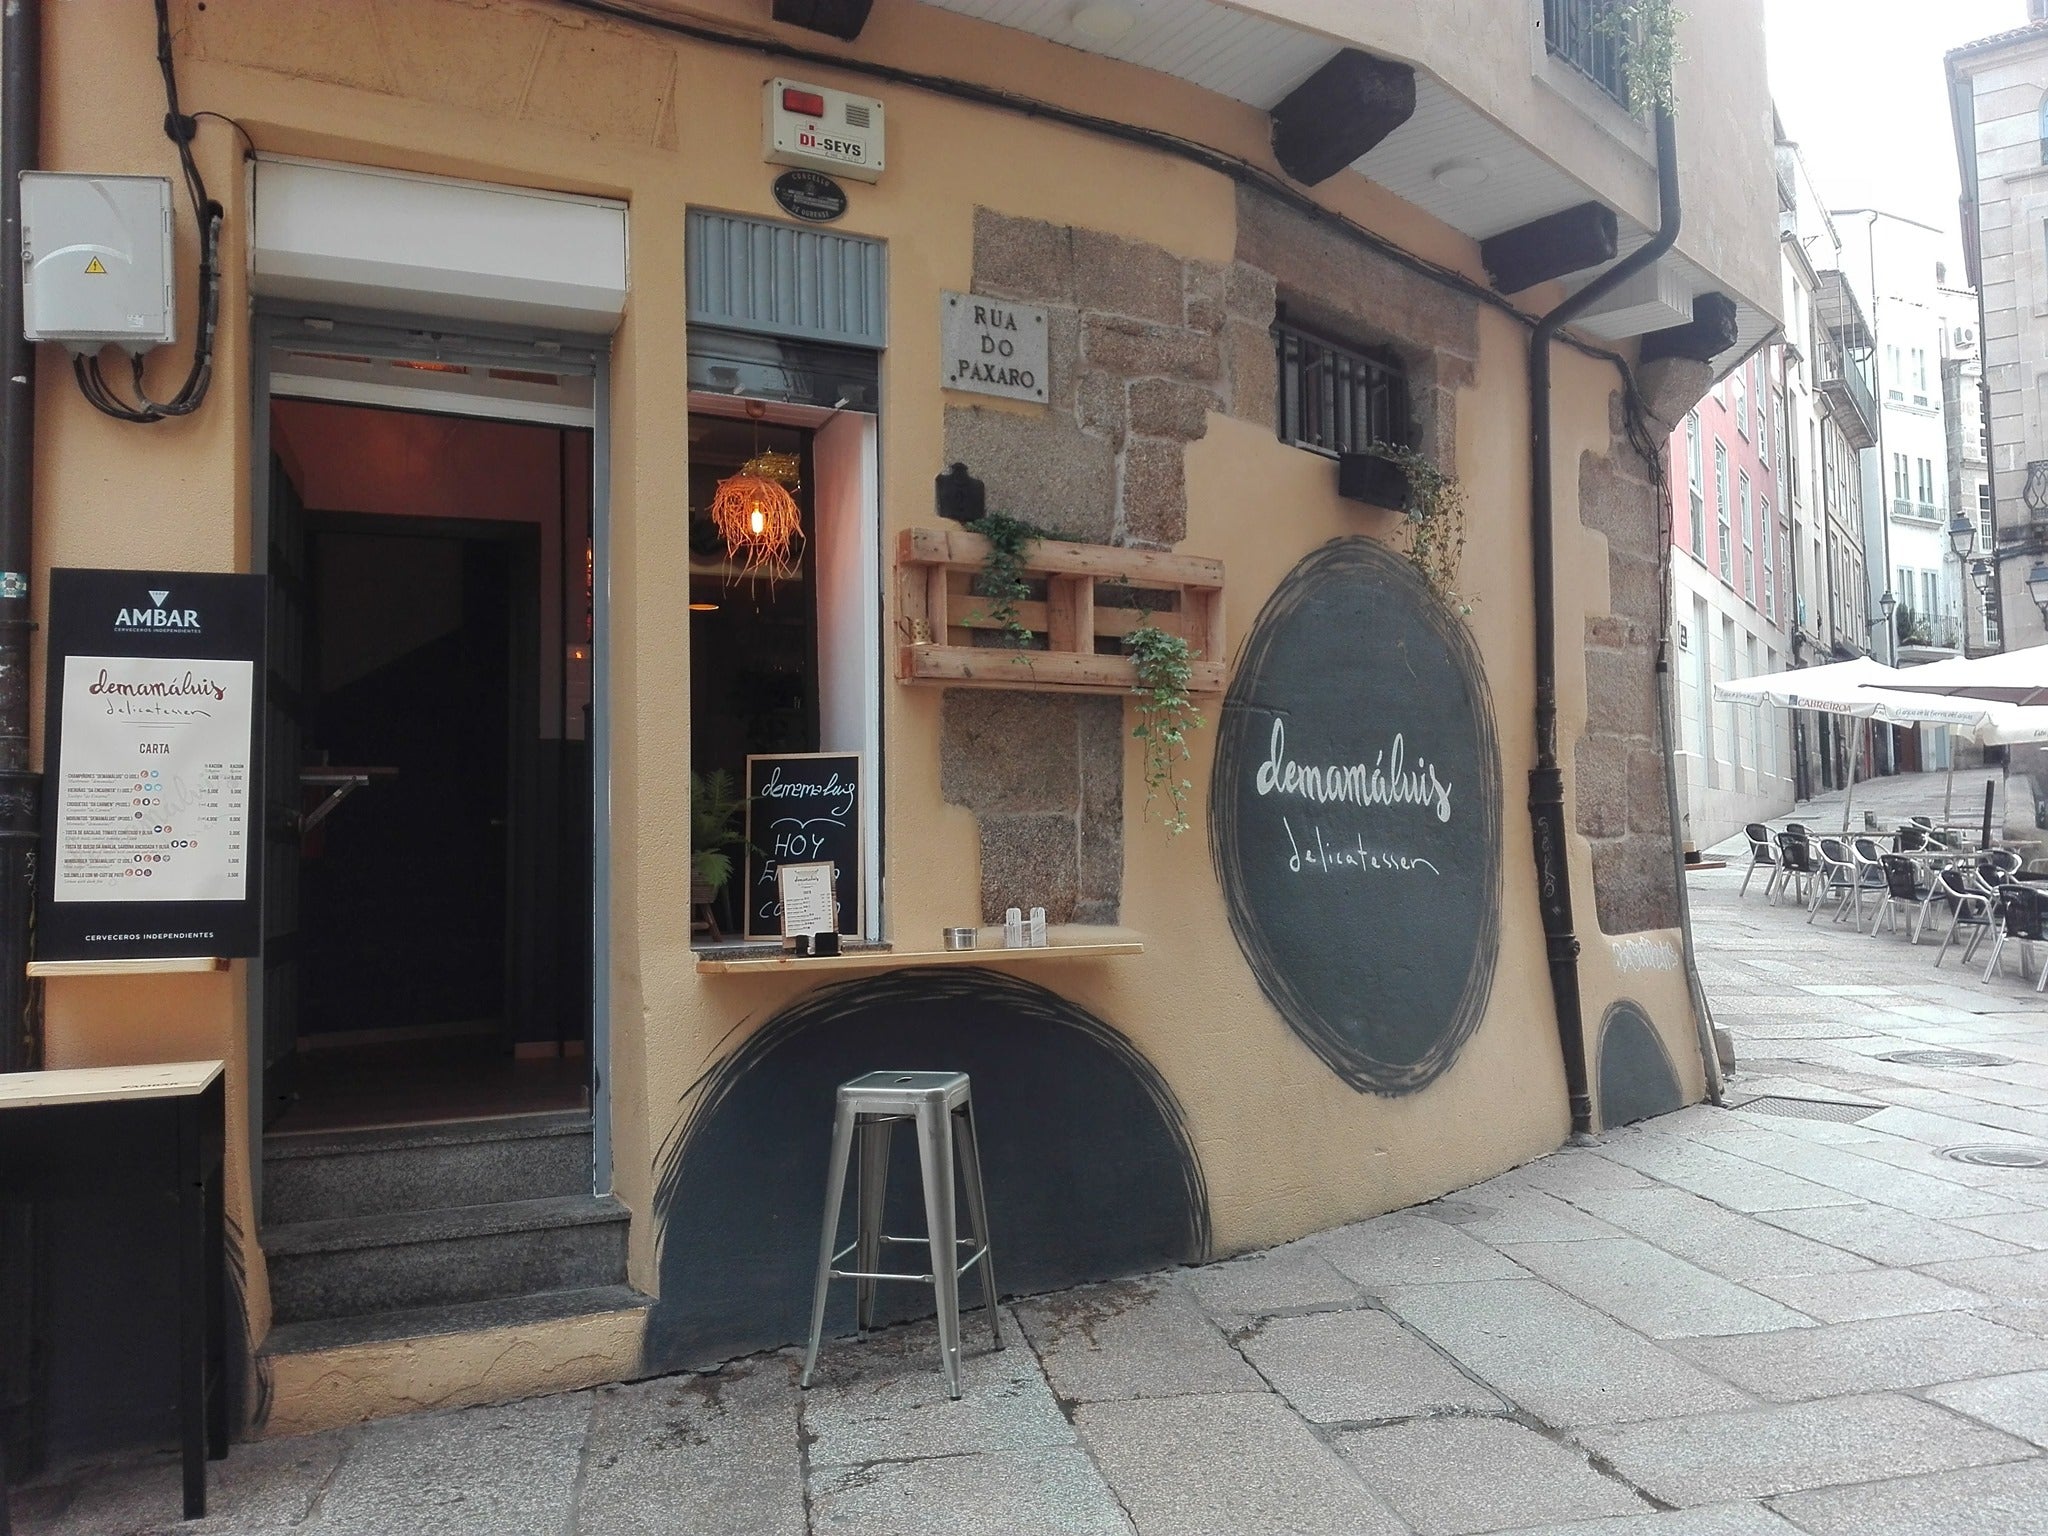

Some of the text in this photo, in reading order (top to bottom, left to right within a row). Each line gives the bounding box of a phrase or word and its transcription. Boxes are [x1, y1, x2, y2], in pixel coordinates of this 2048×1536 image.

[800, 133, 861, 156] DI-SEYS
[974, 305, 1017, 331] RUA
[981, 335, 1014, 357] DO
[958, 359, 1035, 388] PAXARO
[115, 608, 200, 628] AMBAR
[140, 743, 170, 754] CARTA
[1256, 717, 1452, 822] demamáluis
[774, 834, 824, 859] HOY
[1283, 816, 1440, 875] delicatessen
[143, 932, 214, 940] INDEPENDIENTES
